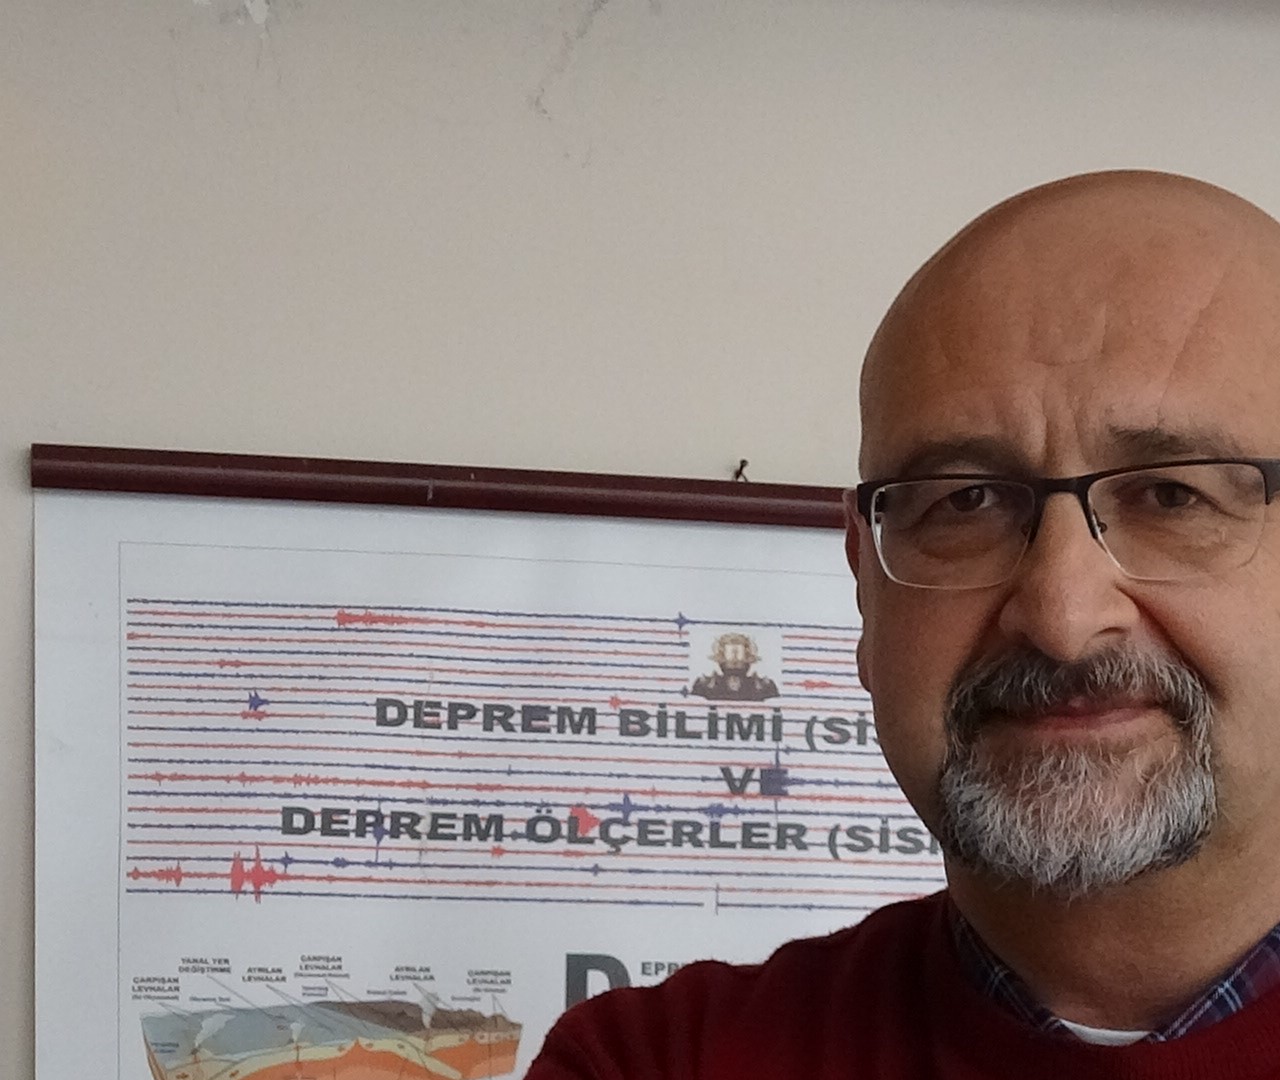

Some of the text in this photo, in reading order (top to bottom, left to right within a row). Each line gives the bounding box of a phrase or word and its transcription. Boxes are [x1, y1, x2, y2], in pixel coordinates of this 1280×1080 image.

[375, 696, 881, 751] DEPREM BİLİMİ (Sİ
[281, 806, 506, 843] DEPREM
[525, 807, 808, 854] ÖLÇERLER
